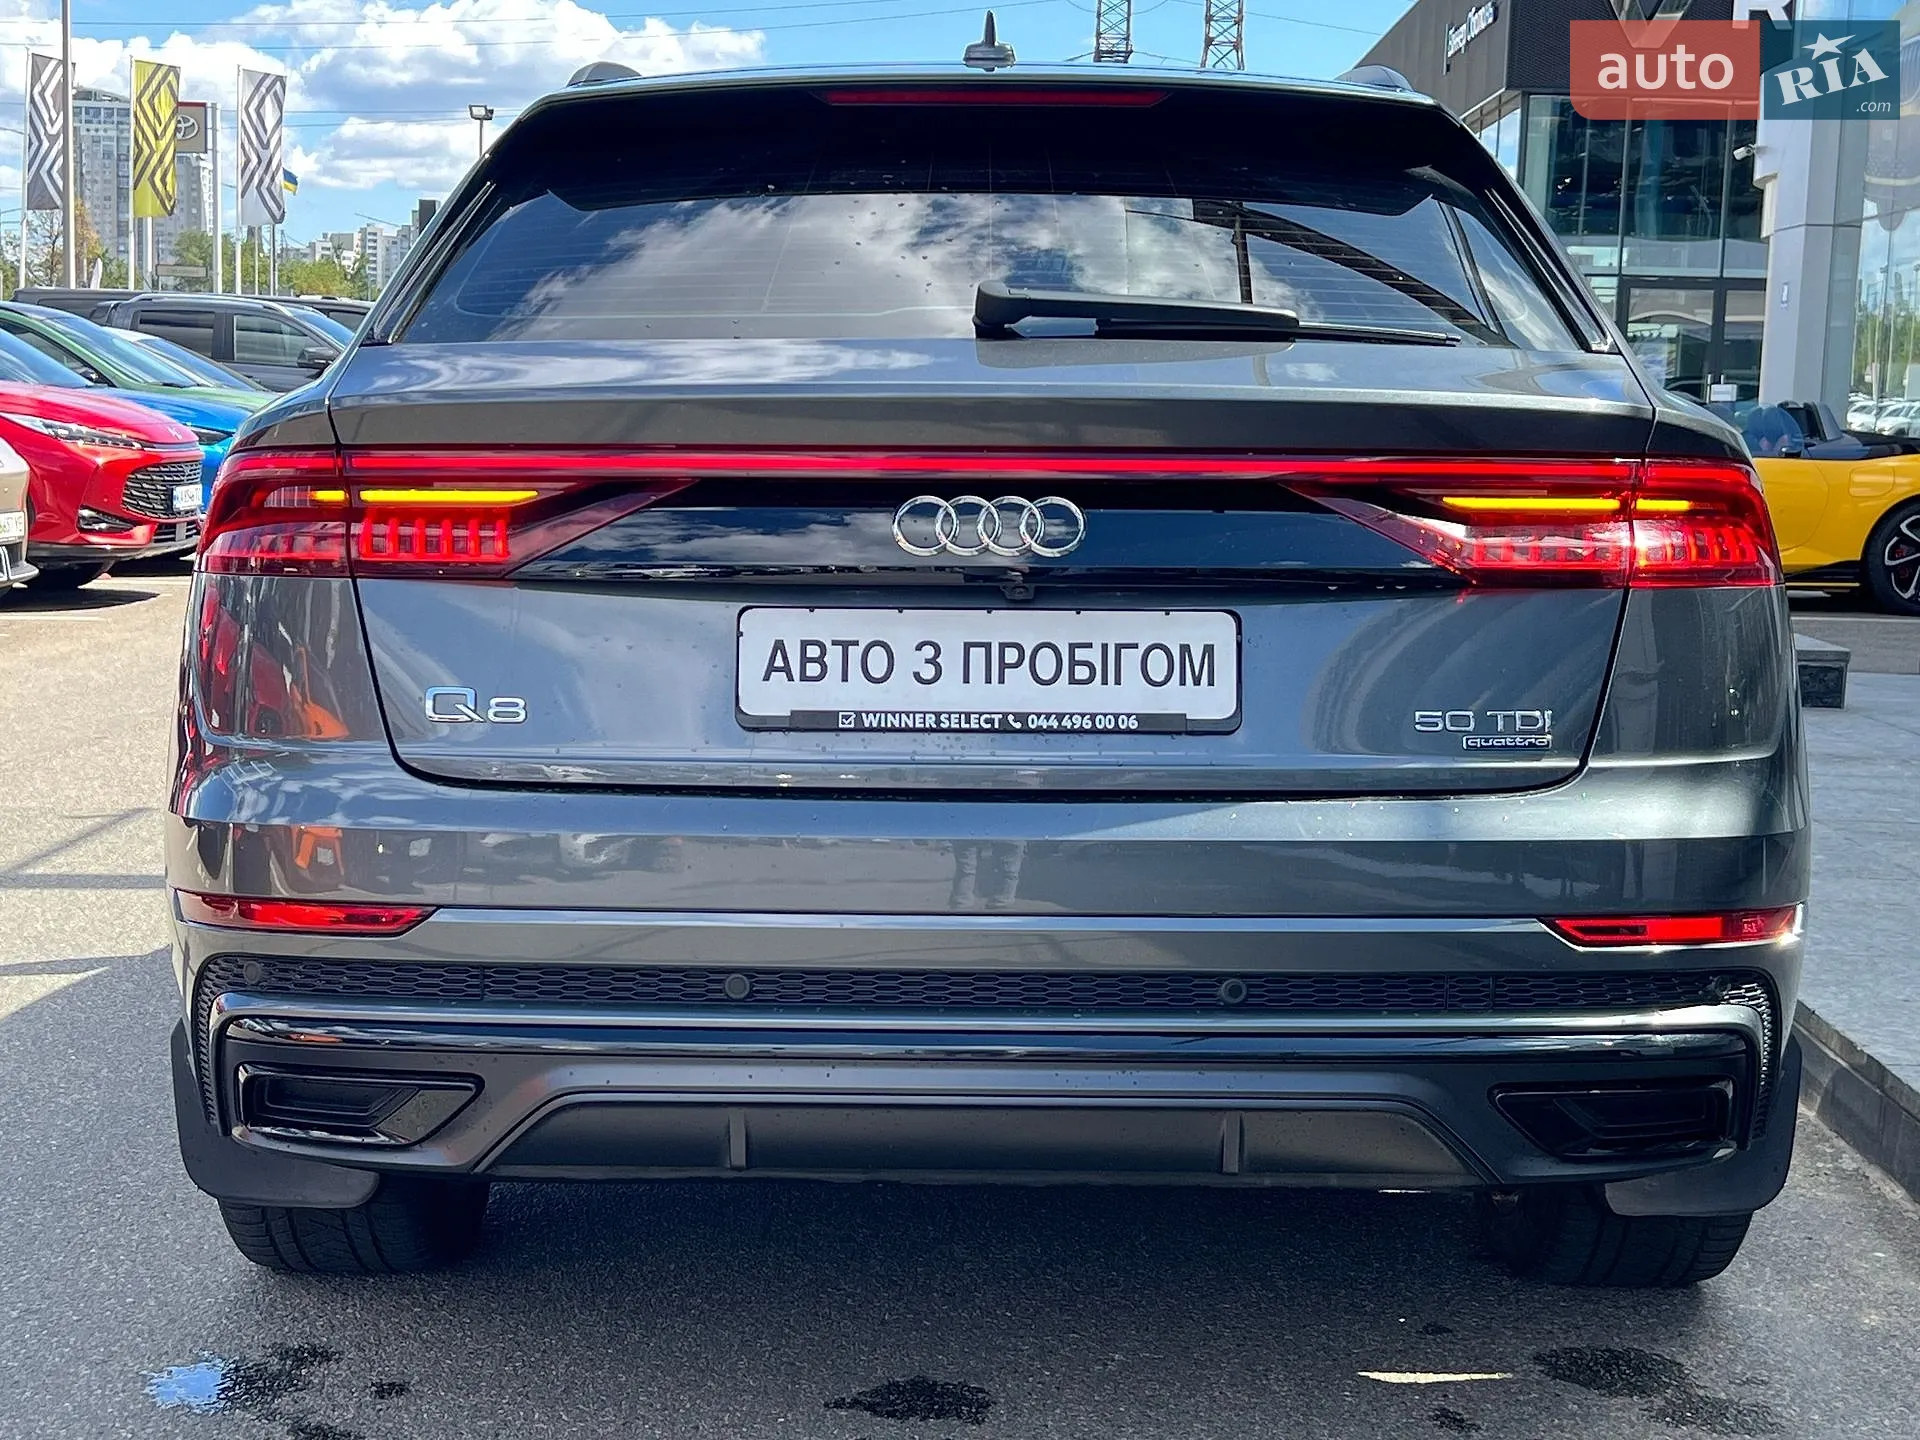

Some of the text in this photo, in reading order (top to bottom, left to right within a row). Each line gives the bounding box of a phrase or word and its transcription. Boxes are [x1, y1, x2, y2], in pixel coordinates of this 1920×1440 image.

[762, 639, 895, 684] АВТО
[962, 641, 1215, 687] ПРОБІГОМ
[425, 686, 527, 723] Q8
[862, 712, 1138, 729] WINNER SELECT 044 496 00 06
[1414, 710, 1552, 732] 50 TDI
[1467, 737, 1548, 748] quattro
